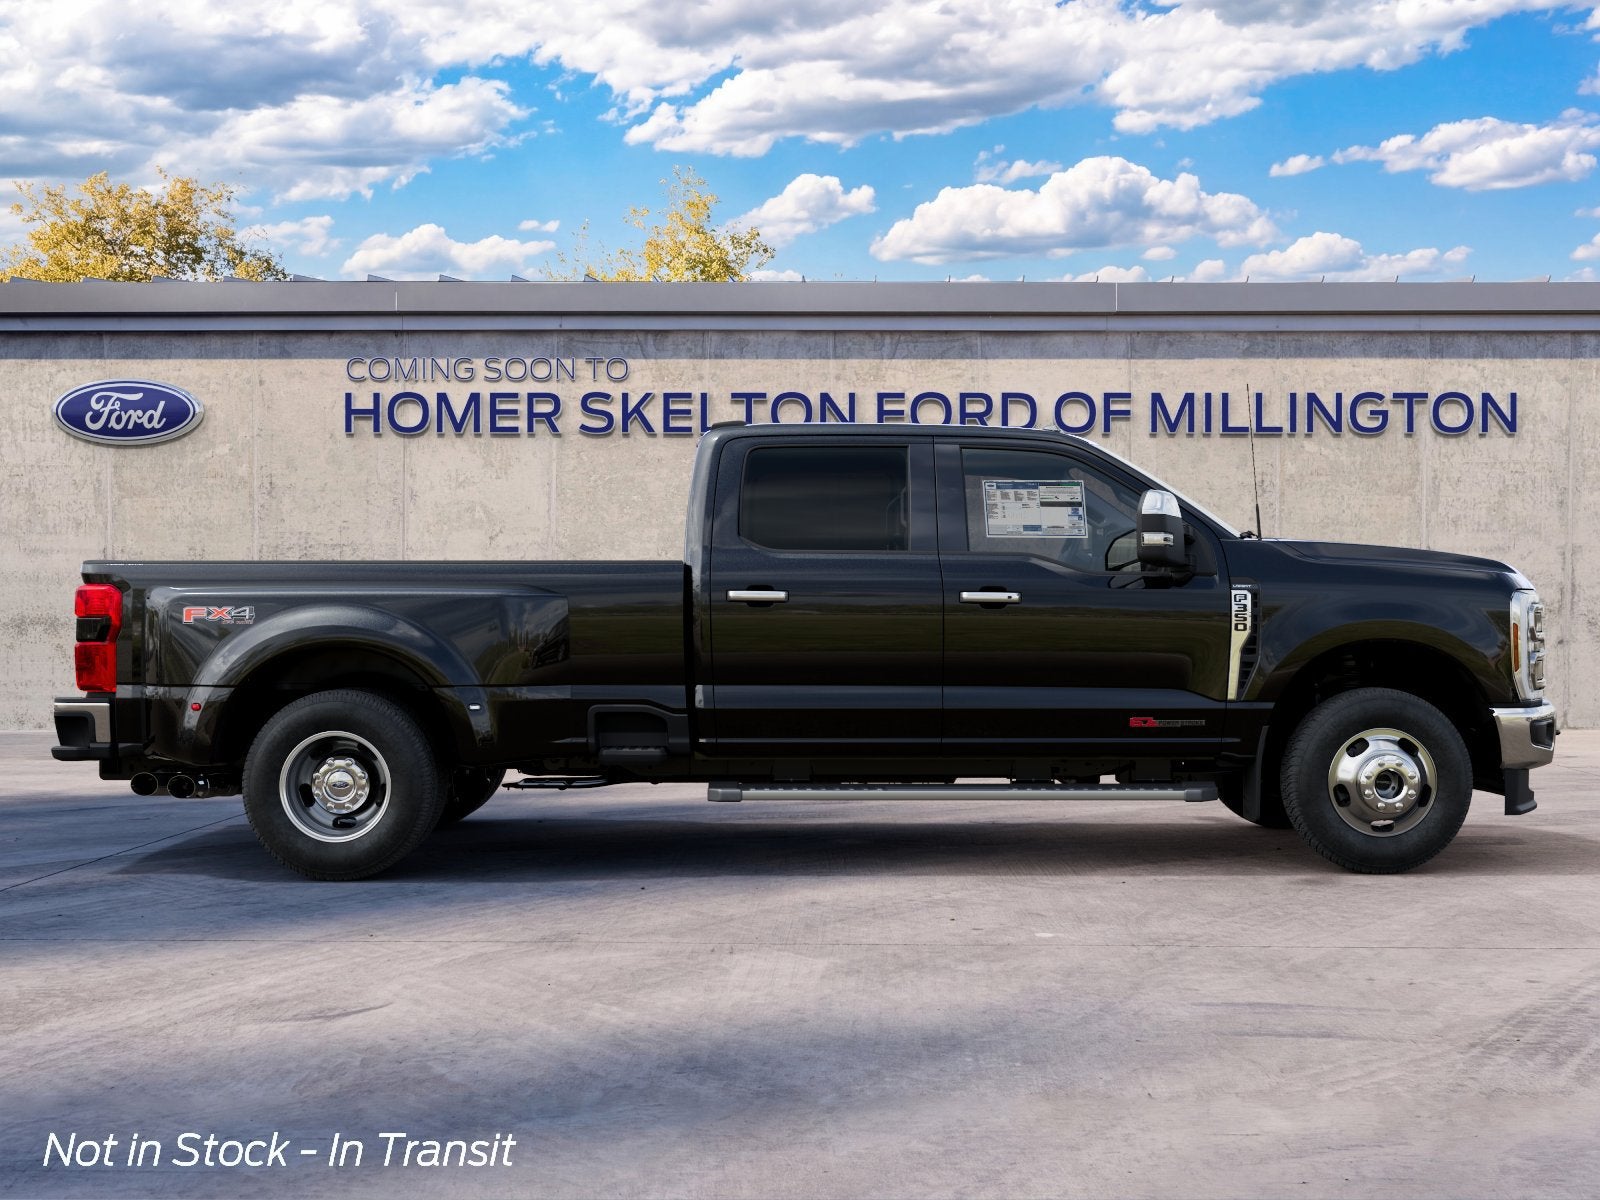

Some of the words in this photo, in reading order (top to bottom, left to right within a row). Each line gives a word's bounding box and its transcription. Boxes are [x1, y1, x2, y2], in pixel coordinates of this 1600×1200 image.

[345, 356, 474, 382] COMING
[483, 356, 576, 382] SOON
[585, 356, 629, 382] TO
[85, 391, 166, 431] Ford
[345, 391, 562, 434] HOMER
[580, 391, 856, 434] SKELTON
[877, 391, 1037, 429] FORD
[1054, 391, 1132, 434] OF
[1150, 391, 1518, 434] MILLINGTON
[182, 606, 256, 625] FX4
